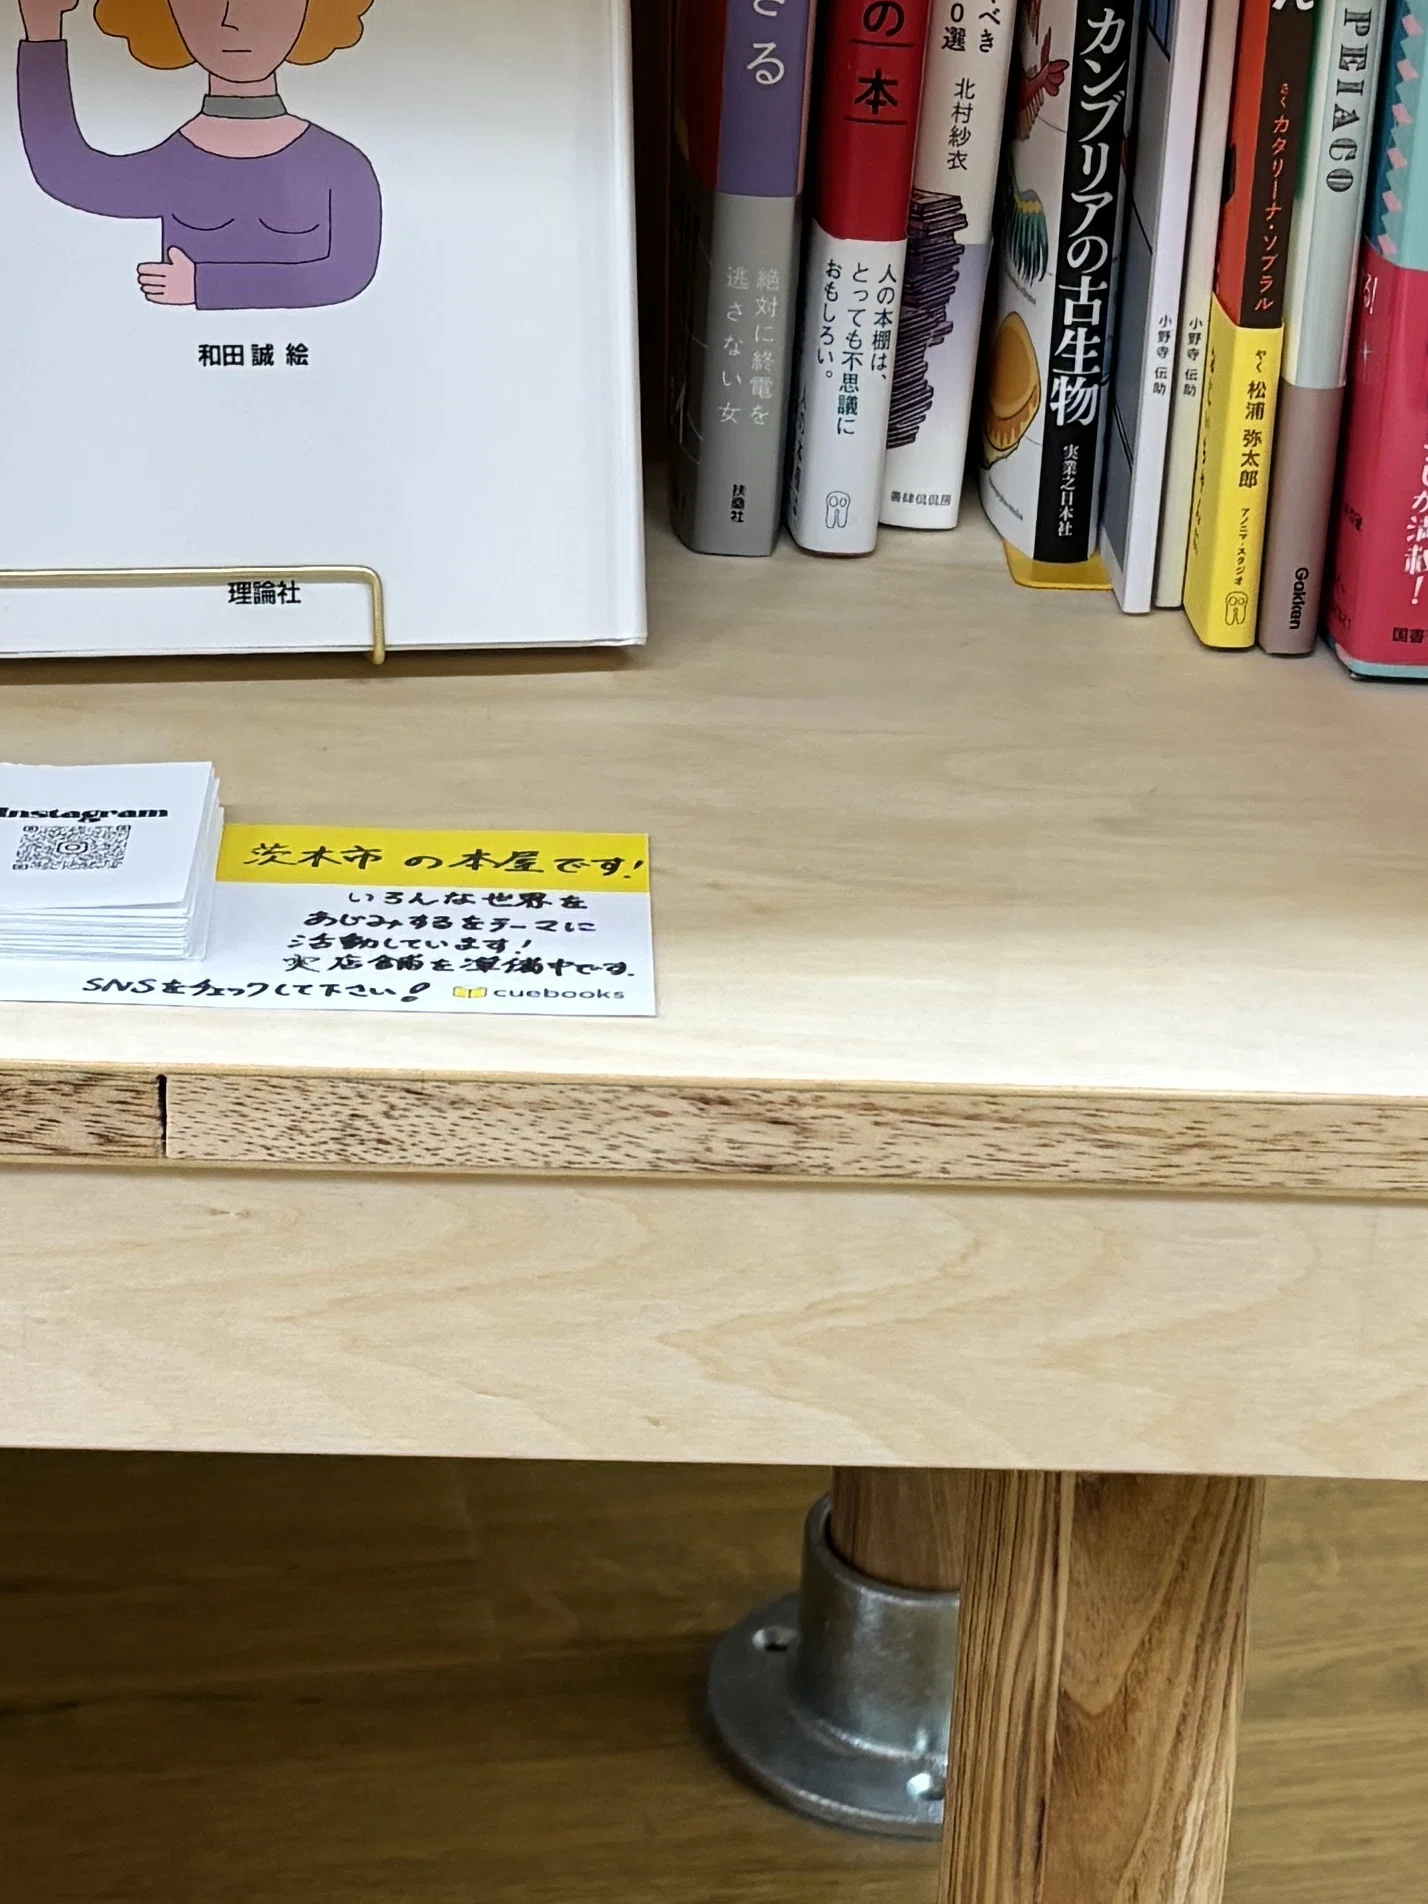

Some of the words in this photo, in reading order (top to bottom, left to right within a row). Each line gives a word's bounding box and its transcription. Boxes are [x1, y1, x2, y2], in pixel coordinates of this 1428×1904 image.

[946, 77, 976, 172] 北村紗衣
[1325, 8, 1371, 193] PEIACO
[1254, 114, 1291, 312] カタリーナ・ソブラル
[198, 342, 246, 369] 和田
[252, 343, 275, 369] 誠
[285, 342, 310, 368] 絵
[718, 265, 749, 425] 逃さない女
[749, 269, 780, 426] 絶対に終電を
[817, 258, 843, 379] おもしろい。
[836, 262, 870, 436] とっても不思議に
[870, 263, 898, 381] 人の本棚は、
[1245, 380, 1267, 421] 松浦
[1057, 443, 1079, 538] 実業之日本社
[1238, 429, 1262, 489] 弥太郎
[227, 579, 303, 607] 理論社
[302, 910, 598, 933] あじみするをテーマに
[348, 891, 589, 910] いろんな世界を
[492, 985, 626, 1000] cuebooks
